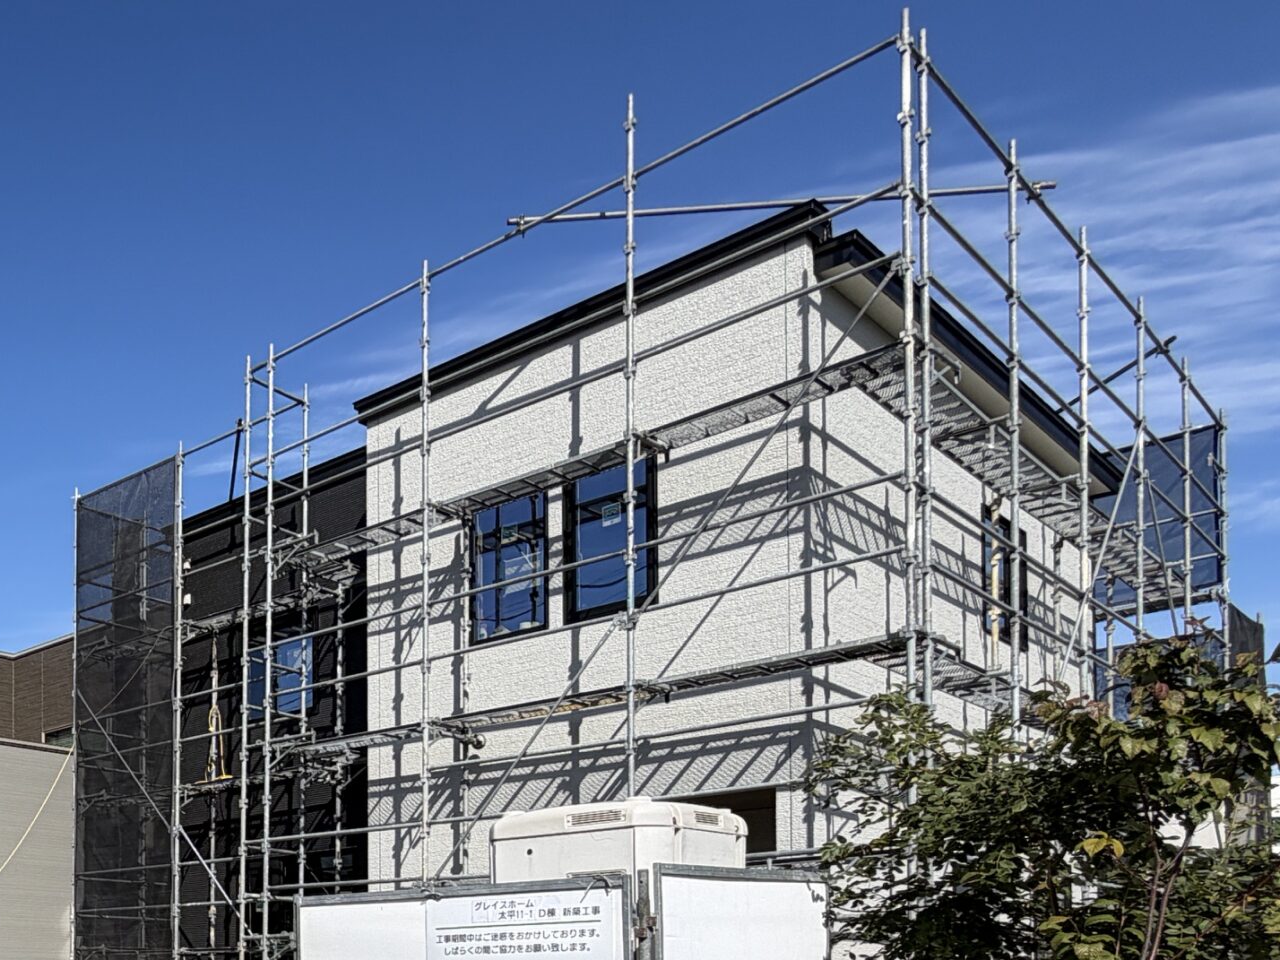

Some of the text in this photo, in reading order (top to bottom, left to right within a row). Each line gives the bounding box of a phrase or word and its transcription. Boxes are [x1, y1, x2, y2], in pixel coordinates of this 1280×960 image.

[474, 899, 535, 911] グレイスホーム
